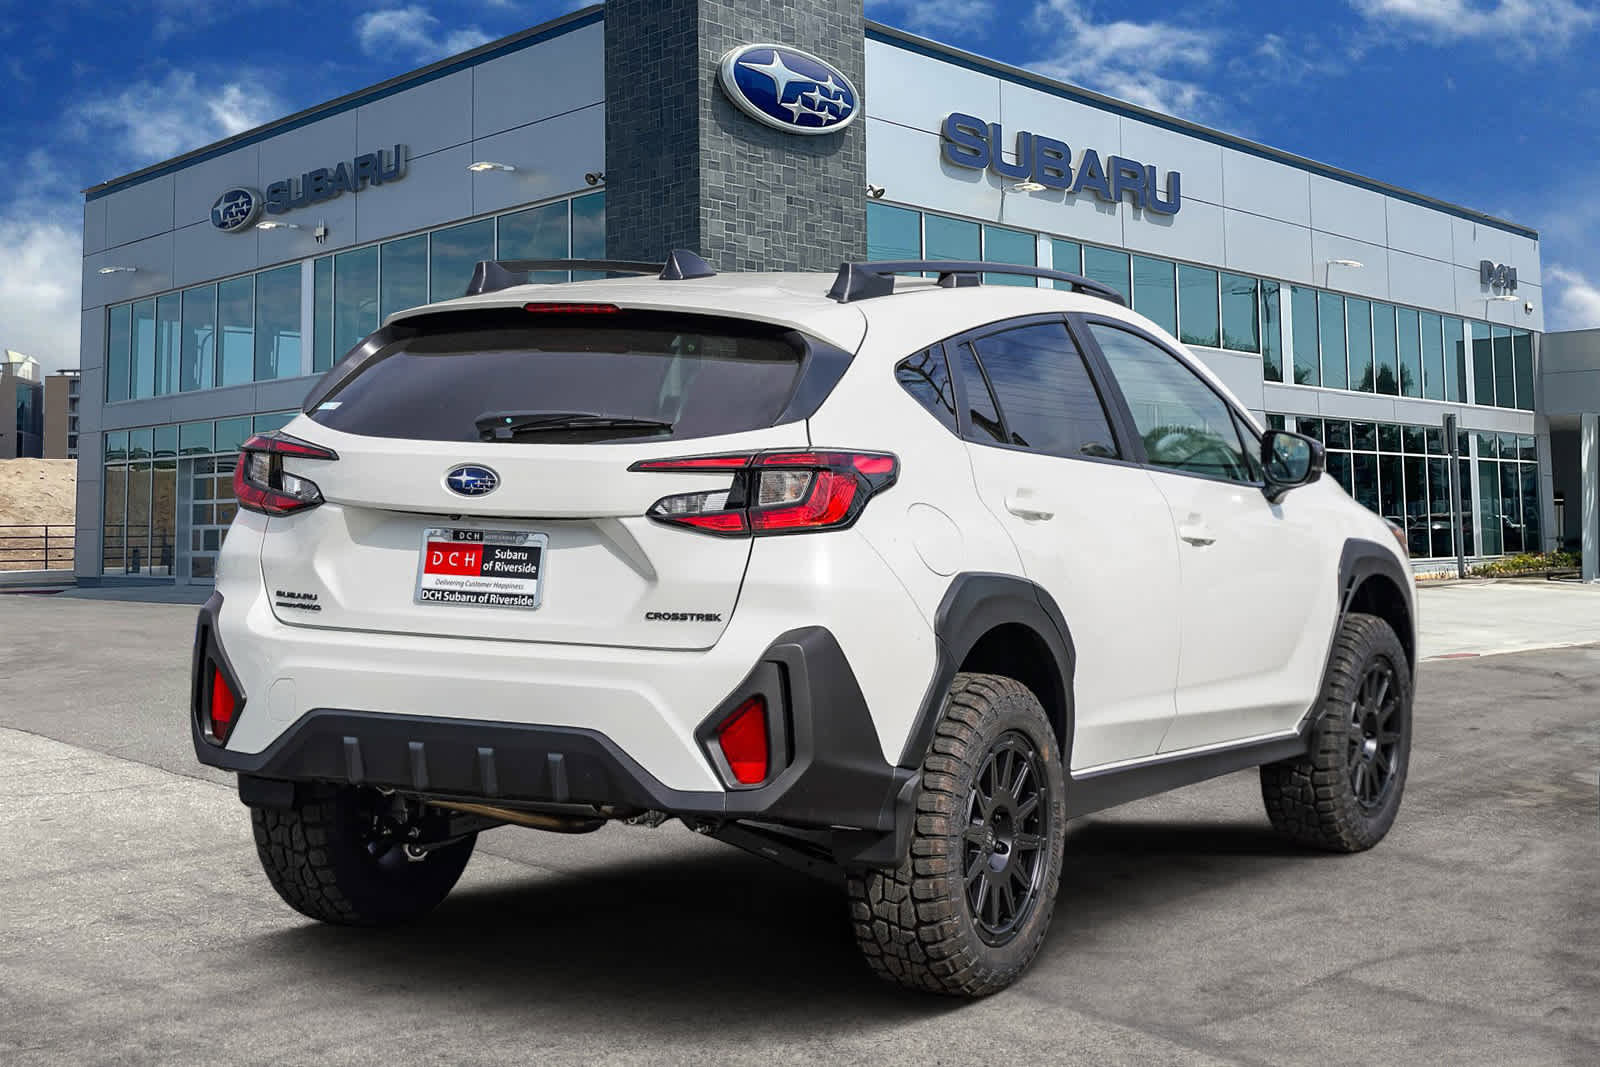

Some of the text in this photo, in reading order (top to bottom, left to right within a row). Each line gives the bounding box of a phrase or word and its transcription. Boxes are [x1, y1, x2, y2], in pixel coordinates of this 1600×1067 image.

[942, 112, 1182, 215] SUBARU
[266, 144, 406, 215] SUBARU
[459, 531, 480, 540] DCH
[432, 551, 476, 567] DCH
[495, 549, 528, 560] Subaru
[482, 561, 537, 573] of Riverside
[435, 579, 464, 588] Delivering
[465, 580, 492, 588] Customer
[422, 589, 533, 606] DCH Subaru of Riverside
[645, 612, 722, 622] CROSSTREK
